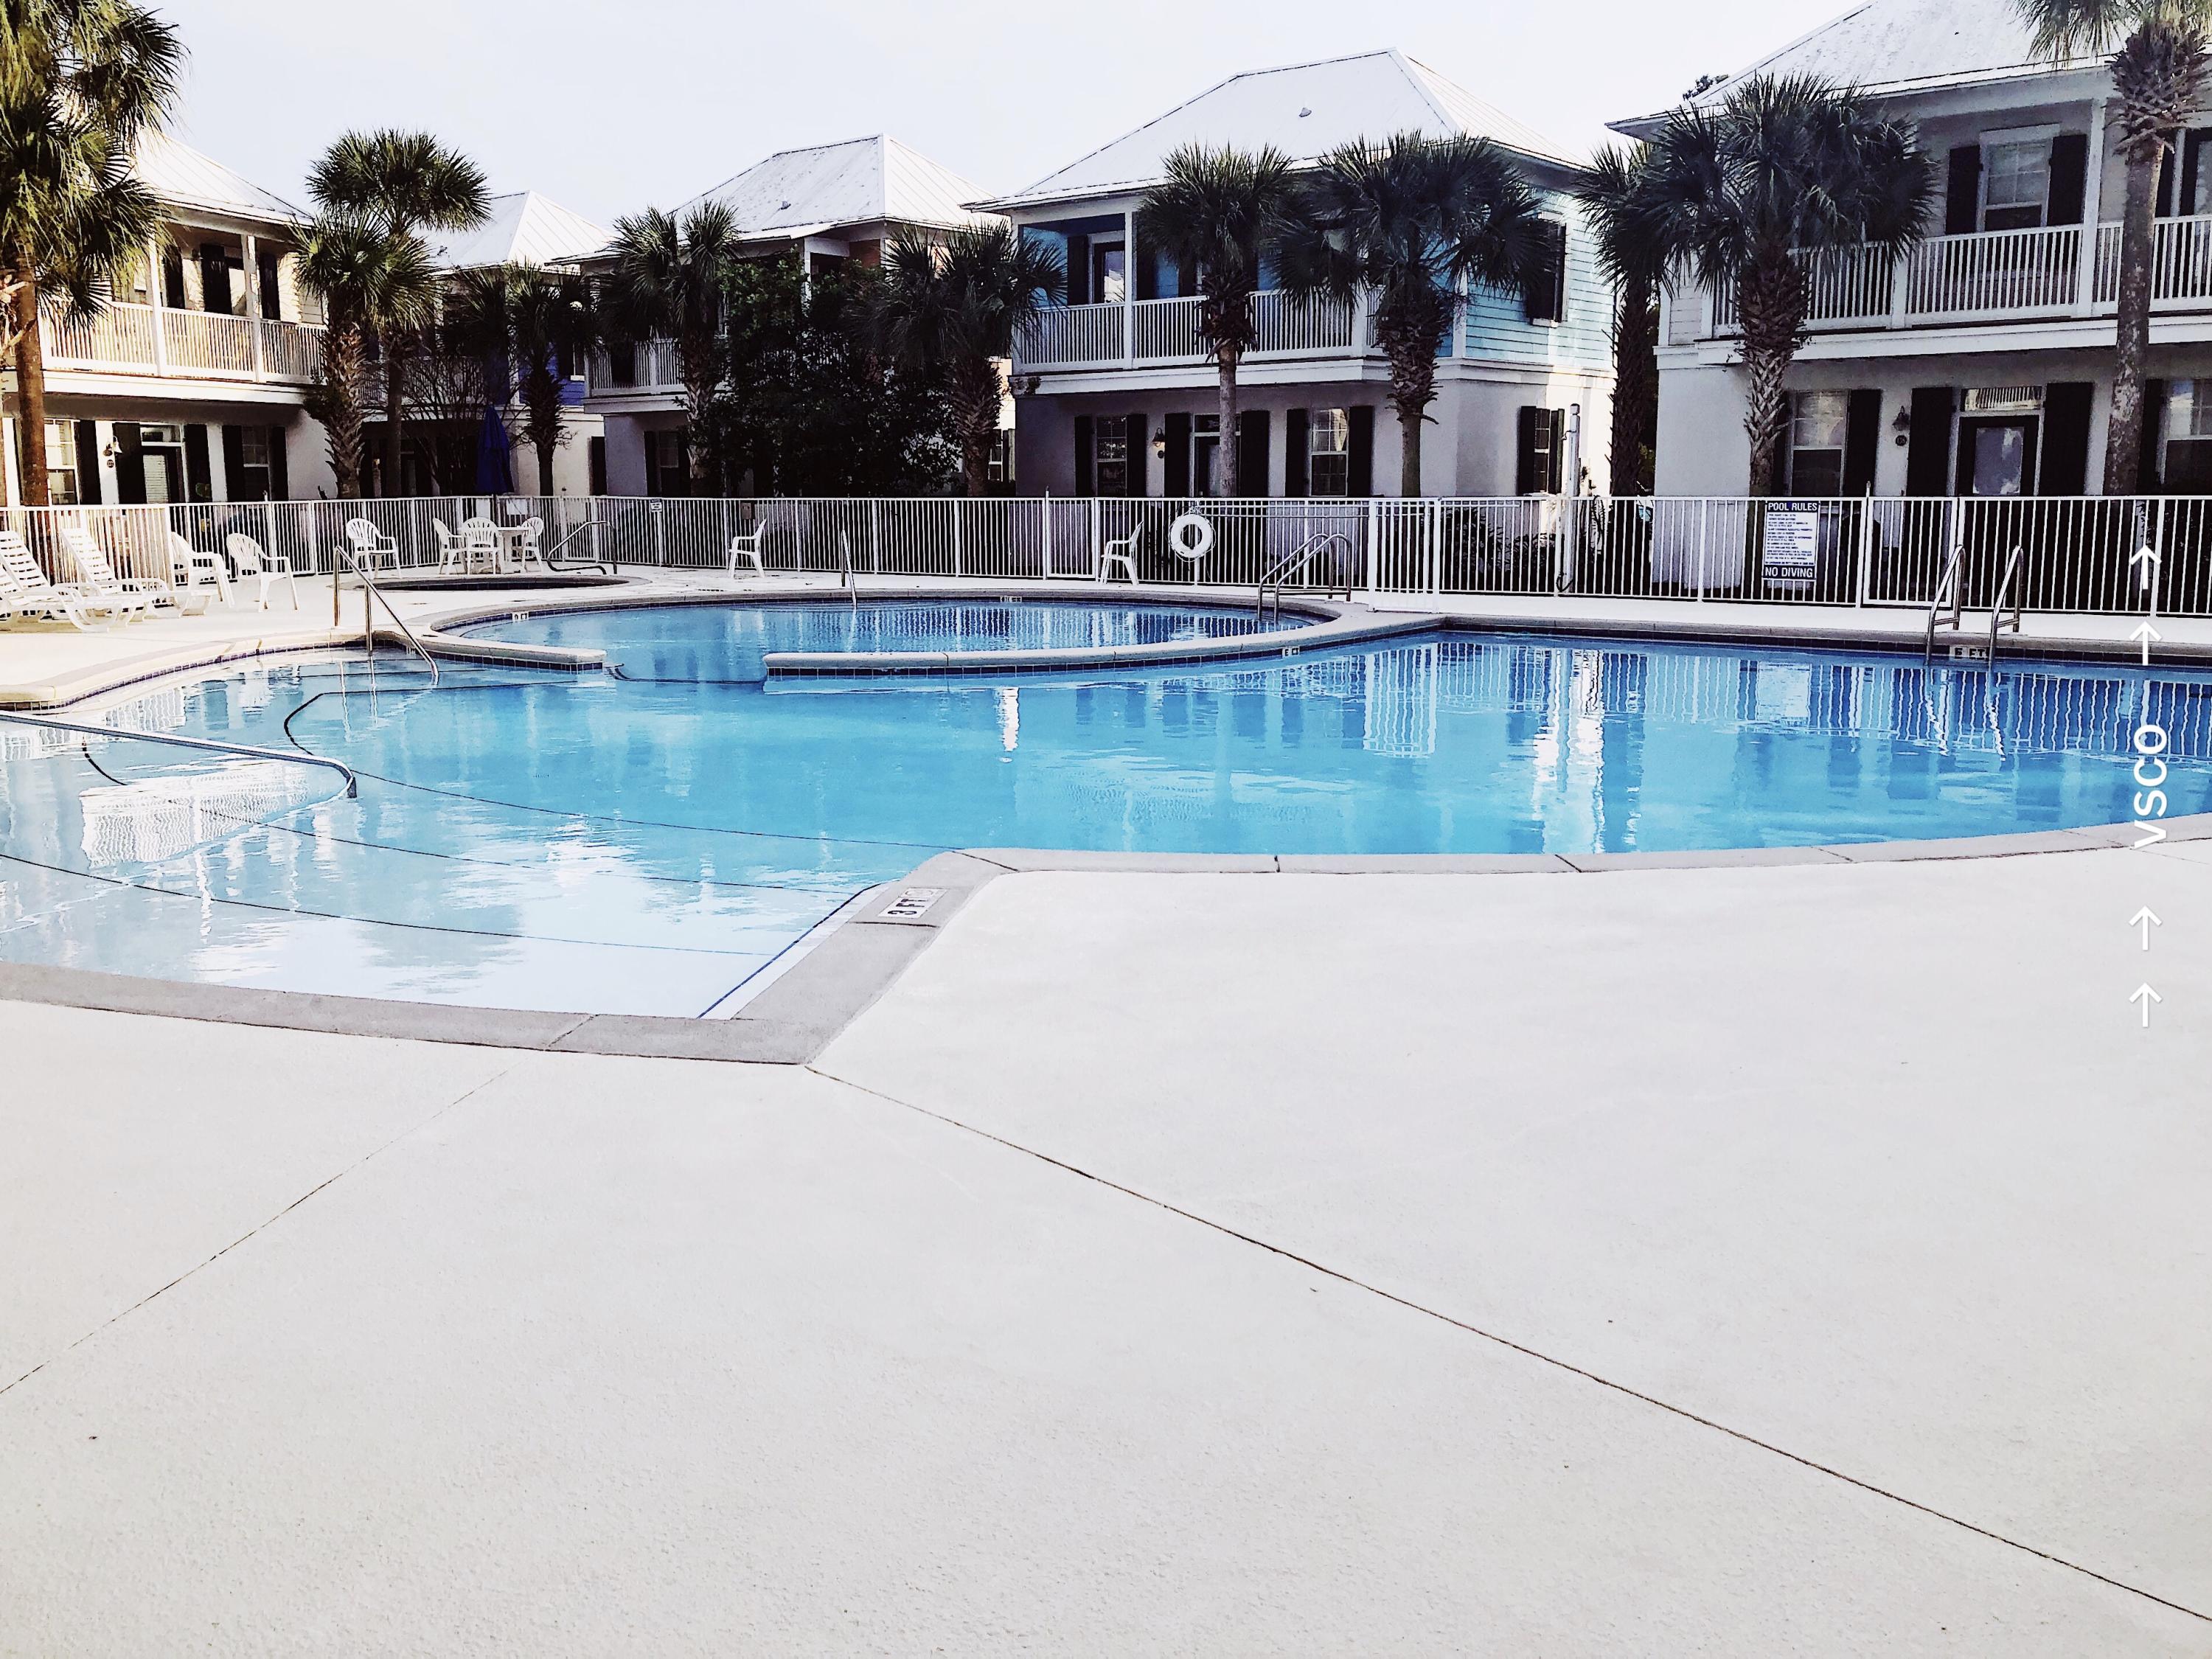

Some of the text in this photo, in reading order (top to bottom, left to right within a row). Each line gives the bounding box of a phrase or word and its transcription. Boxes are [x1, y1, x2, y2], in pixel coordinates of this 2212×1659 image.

[1767, 502, 1818, 511] POOL RULES
[1764, 566, 1813, 577] NO DIVING
[895, 898, 929, 908] FT
